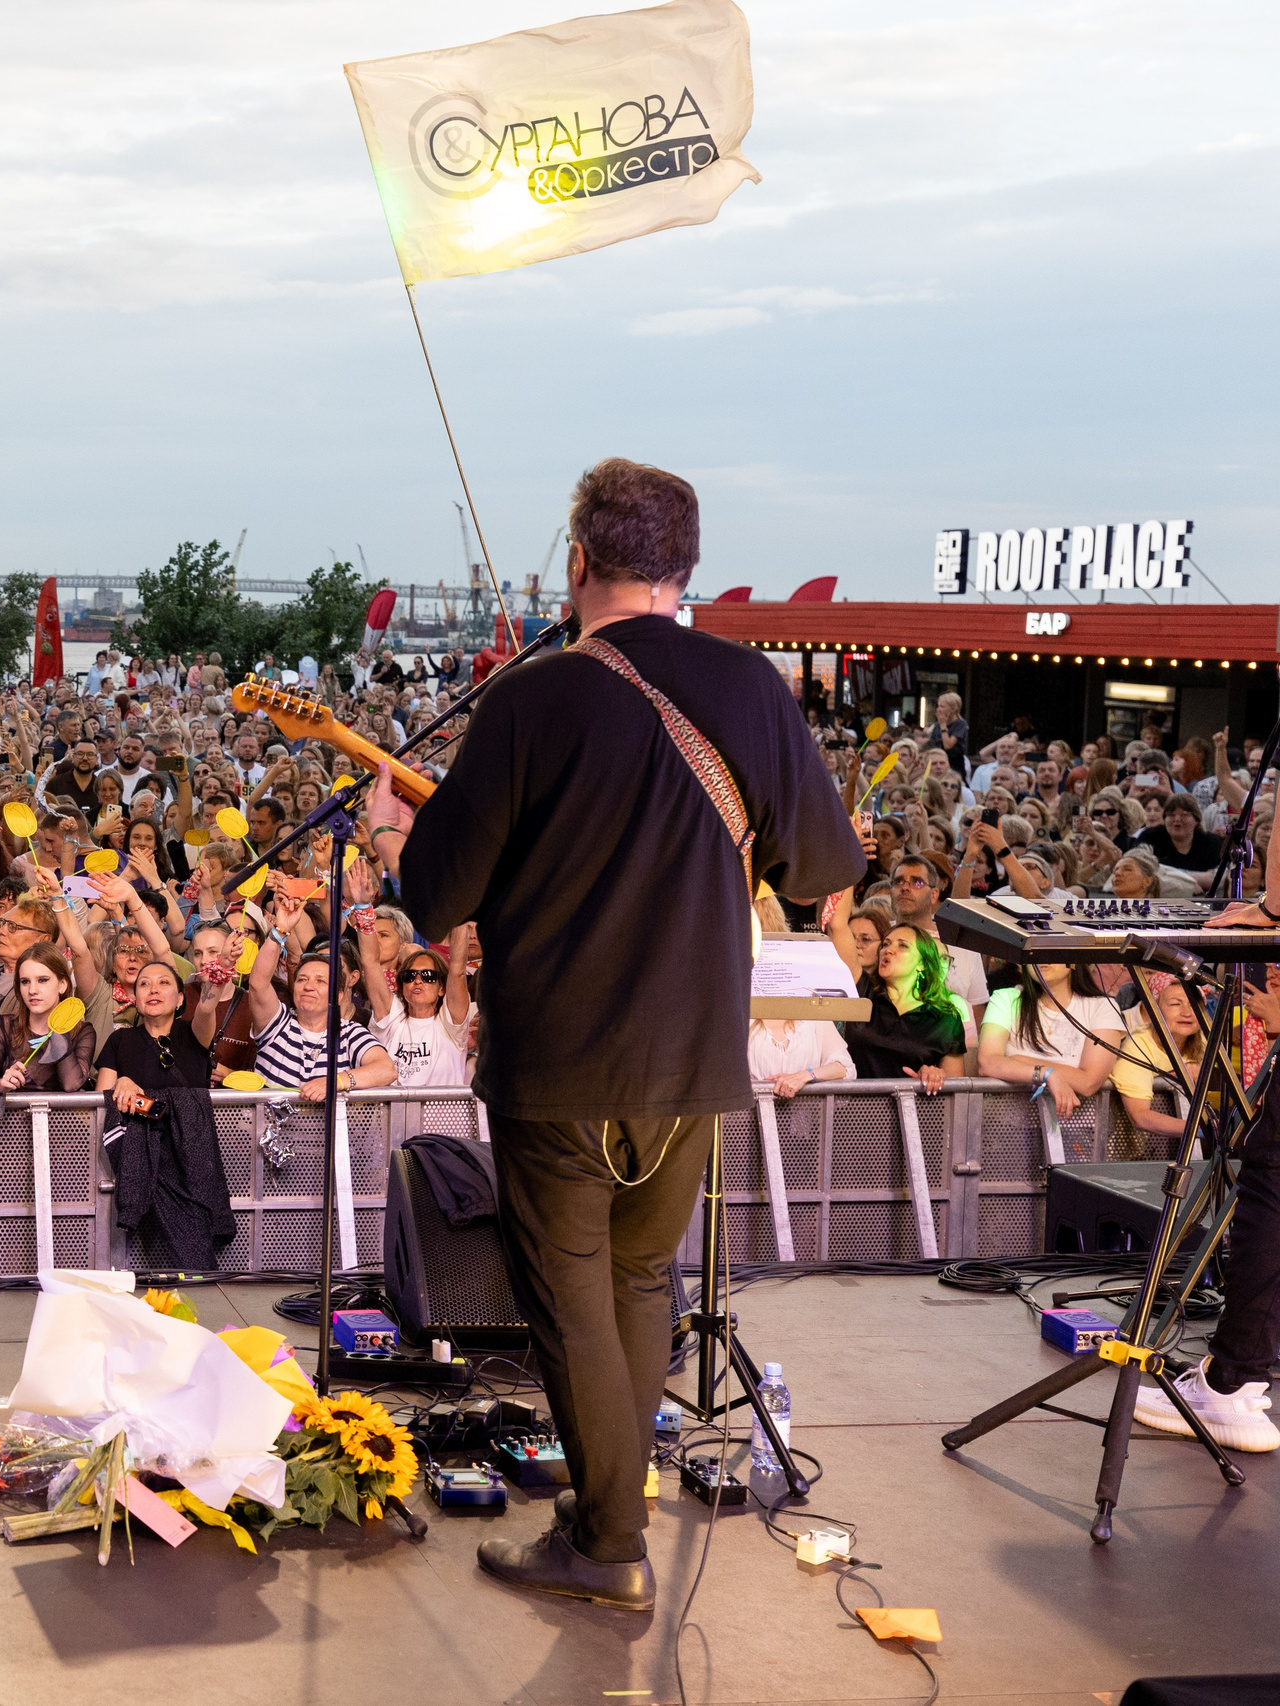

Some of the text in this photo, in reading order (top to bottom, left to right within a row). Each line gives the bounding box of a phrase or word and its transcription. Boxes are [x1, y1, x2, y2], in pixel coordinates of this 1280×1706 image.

[428, 85, 711, 178] СУРГАНОВА
[975, 519, 1192, 593] ROOF PLACE
[1025, 612, 1069, 636] БАР
